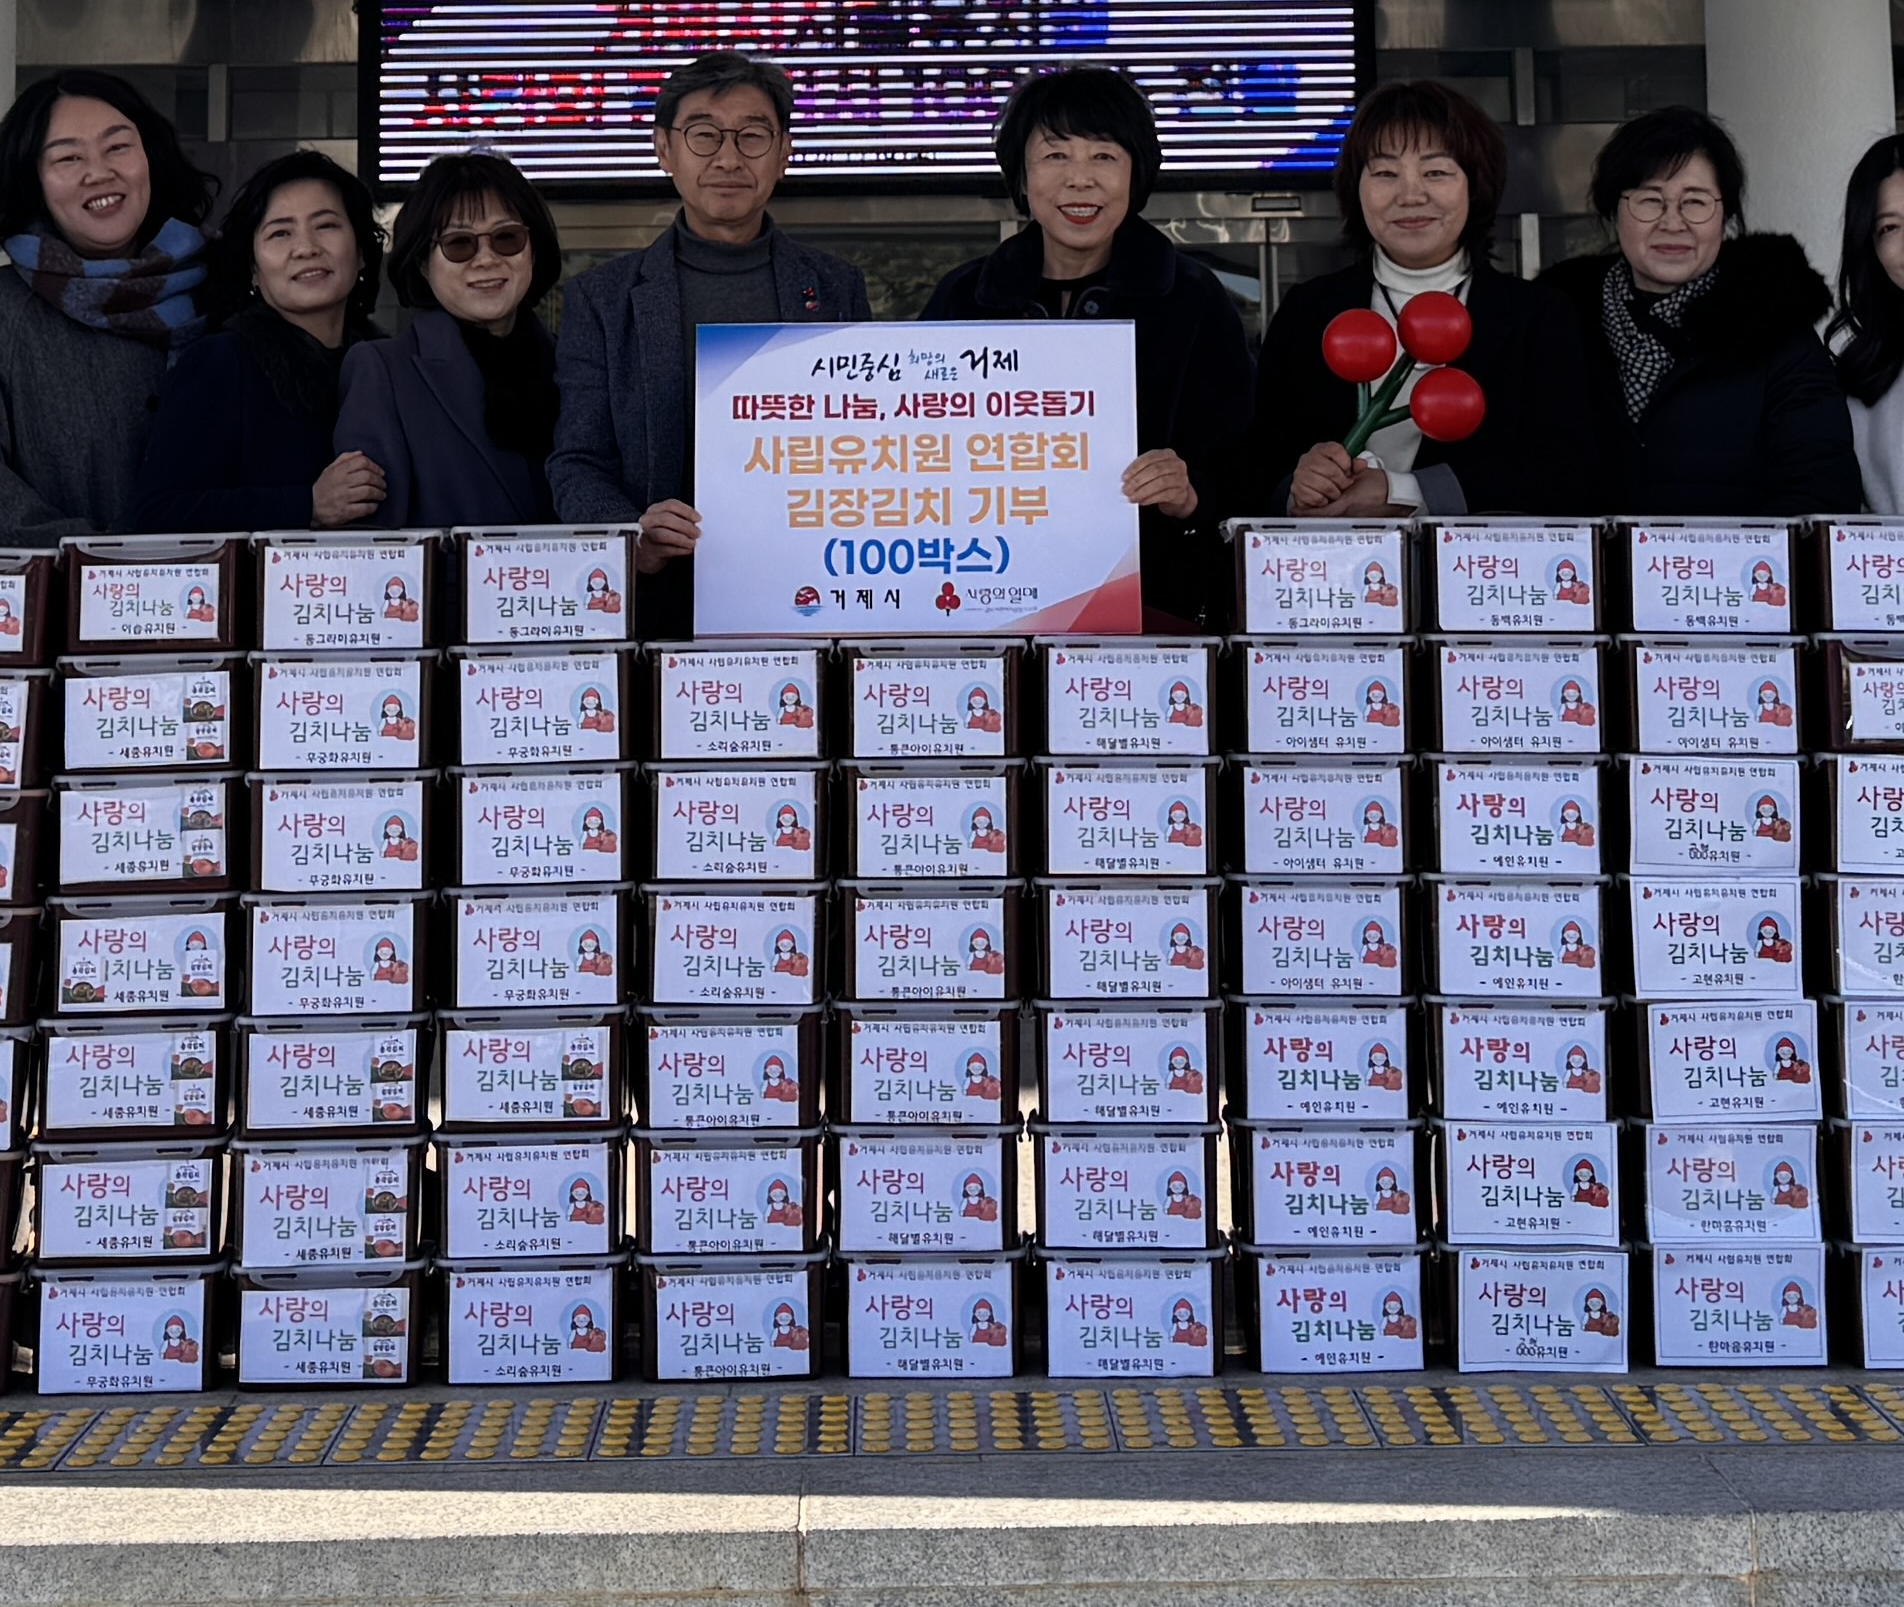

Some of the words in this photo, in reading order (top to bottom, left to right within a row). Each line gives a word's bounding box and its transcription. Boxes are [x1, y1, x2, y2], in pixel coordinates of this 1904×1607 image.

[811, 352, 901, 382] 시민중심
[959, 346, 1019, 379] 거제
[907, 349, 945, 366] 희망의
[924, 367, 958, 381] 새로운
[732, 395, 815, 421] 따뜻한
[824, 394, 886, 422] 나눔,
[893, 392, 975, 419] 사랑의
[986, 391, 1095, 417] 이웃돕기
[744, 433, 952, 475] 사립유치원
[966, 431, 1089, 472] 연합회
[787, 486, 951, 529] 김장김치
[969, 485, 1049, 525] 기부
[823, 536, 1010, 577] (100박스)
[1453, 555, 1518, 580] 사랑의
[280, 573, 347, 598] 사랑의
[1467, 581, 1550, 606] 김치나눔
[293, 603, 376, 625] 김치나눔
[679, 658, 704, 667] 거제시
[773, 656, 799, 666] 연합회
[867, 660, 892, 670] 거제시
[961, 660, 987, 670] 연합회
[676, 680, 742, 706] 사랑의
[863, 683, 929, 708] 사랑의
[1065, 677, 1131, 702] 사랑의
[1653, 676, 1719, 701] 사랑의
[276, 690, 343, 716] 사랑의
[1079, 703, 1163, 729] 김치나눔
[1668, 702, 1752, 728] 김치나눔
[289, 721, 372, 743] 김치나눔
[690, 706, 773, 732] 김치나눔
[877, 709, 961, 735] 김치나눔
[1729, 738, 1759, 750] 유치원
[306, 751, 371, 764] 무궁화유치원
[1654, 888, 1679, 898] 거제시
[1751, 888, 1777, 899] 연합회
[1257, 915, 1324, 941] 사랑의
[1653, 911, 1719, 938] 사랑의
[1272, 943, 1357, 969] 김치나눔
[1667, 939, 1752, 965] 김치나눔
[1332, 978, 1362, 990] 유치원
[1692, 973, 1744, 986] 고현유치원
[1469, 1130, 1495, 1140] 거제시
[1567, 1131, 1593, 1141] 연합회
[1270, 1161, 1340, 1187] 사랑의
[1466, 1153, 1535, 1180] 사랑의
[60, 1173, 130, 1200] 사랑의
[661, 1175, 728, 1203] 사랑의
[1481, 1182, 1568, 1208] 김치나눔
[1284, 1189, 1372, 1216] 김치나눔
[74, 1204, 159, 1228] 김치나눔
[675, 1204, 761, 1231] 김치나눔
[1505, 1217, 1560, 1230] 고현유치원
[467, 1277, 493, 1288] 거제시
[565, 1275, 591, 1287] 연합회
[464, 1301, 532, 1328] 사랑의
[865, 1294, 933, 1321] 사랑의
[1065, 1293, 1133, 1320] 사랑의
[56, 1312, 124, 1338] 사랑의
[880, 1323, 966, 1349] 김치나눔
[1079, 1322, 1166, 1349] 김치나눔
[69, 1340, 157, 1367] 김치나눔
[477, 1333, 562, 1356] 김치나눔
[86, 1375, 153, 1388] 무궁화유치원
